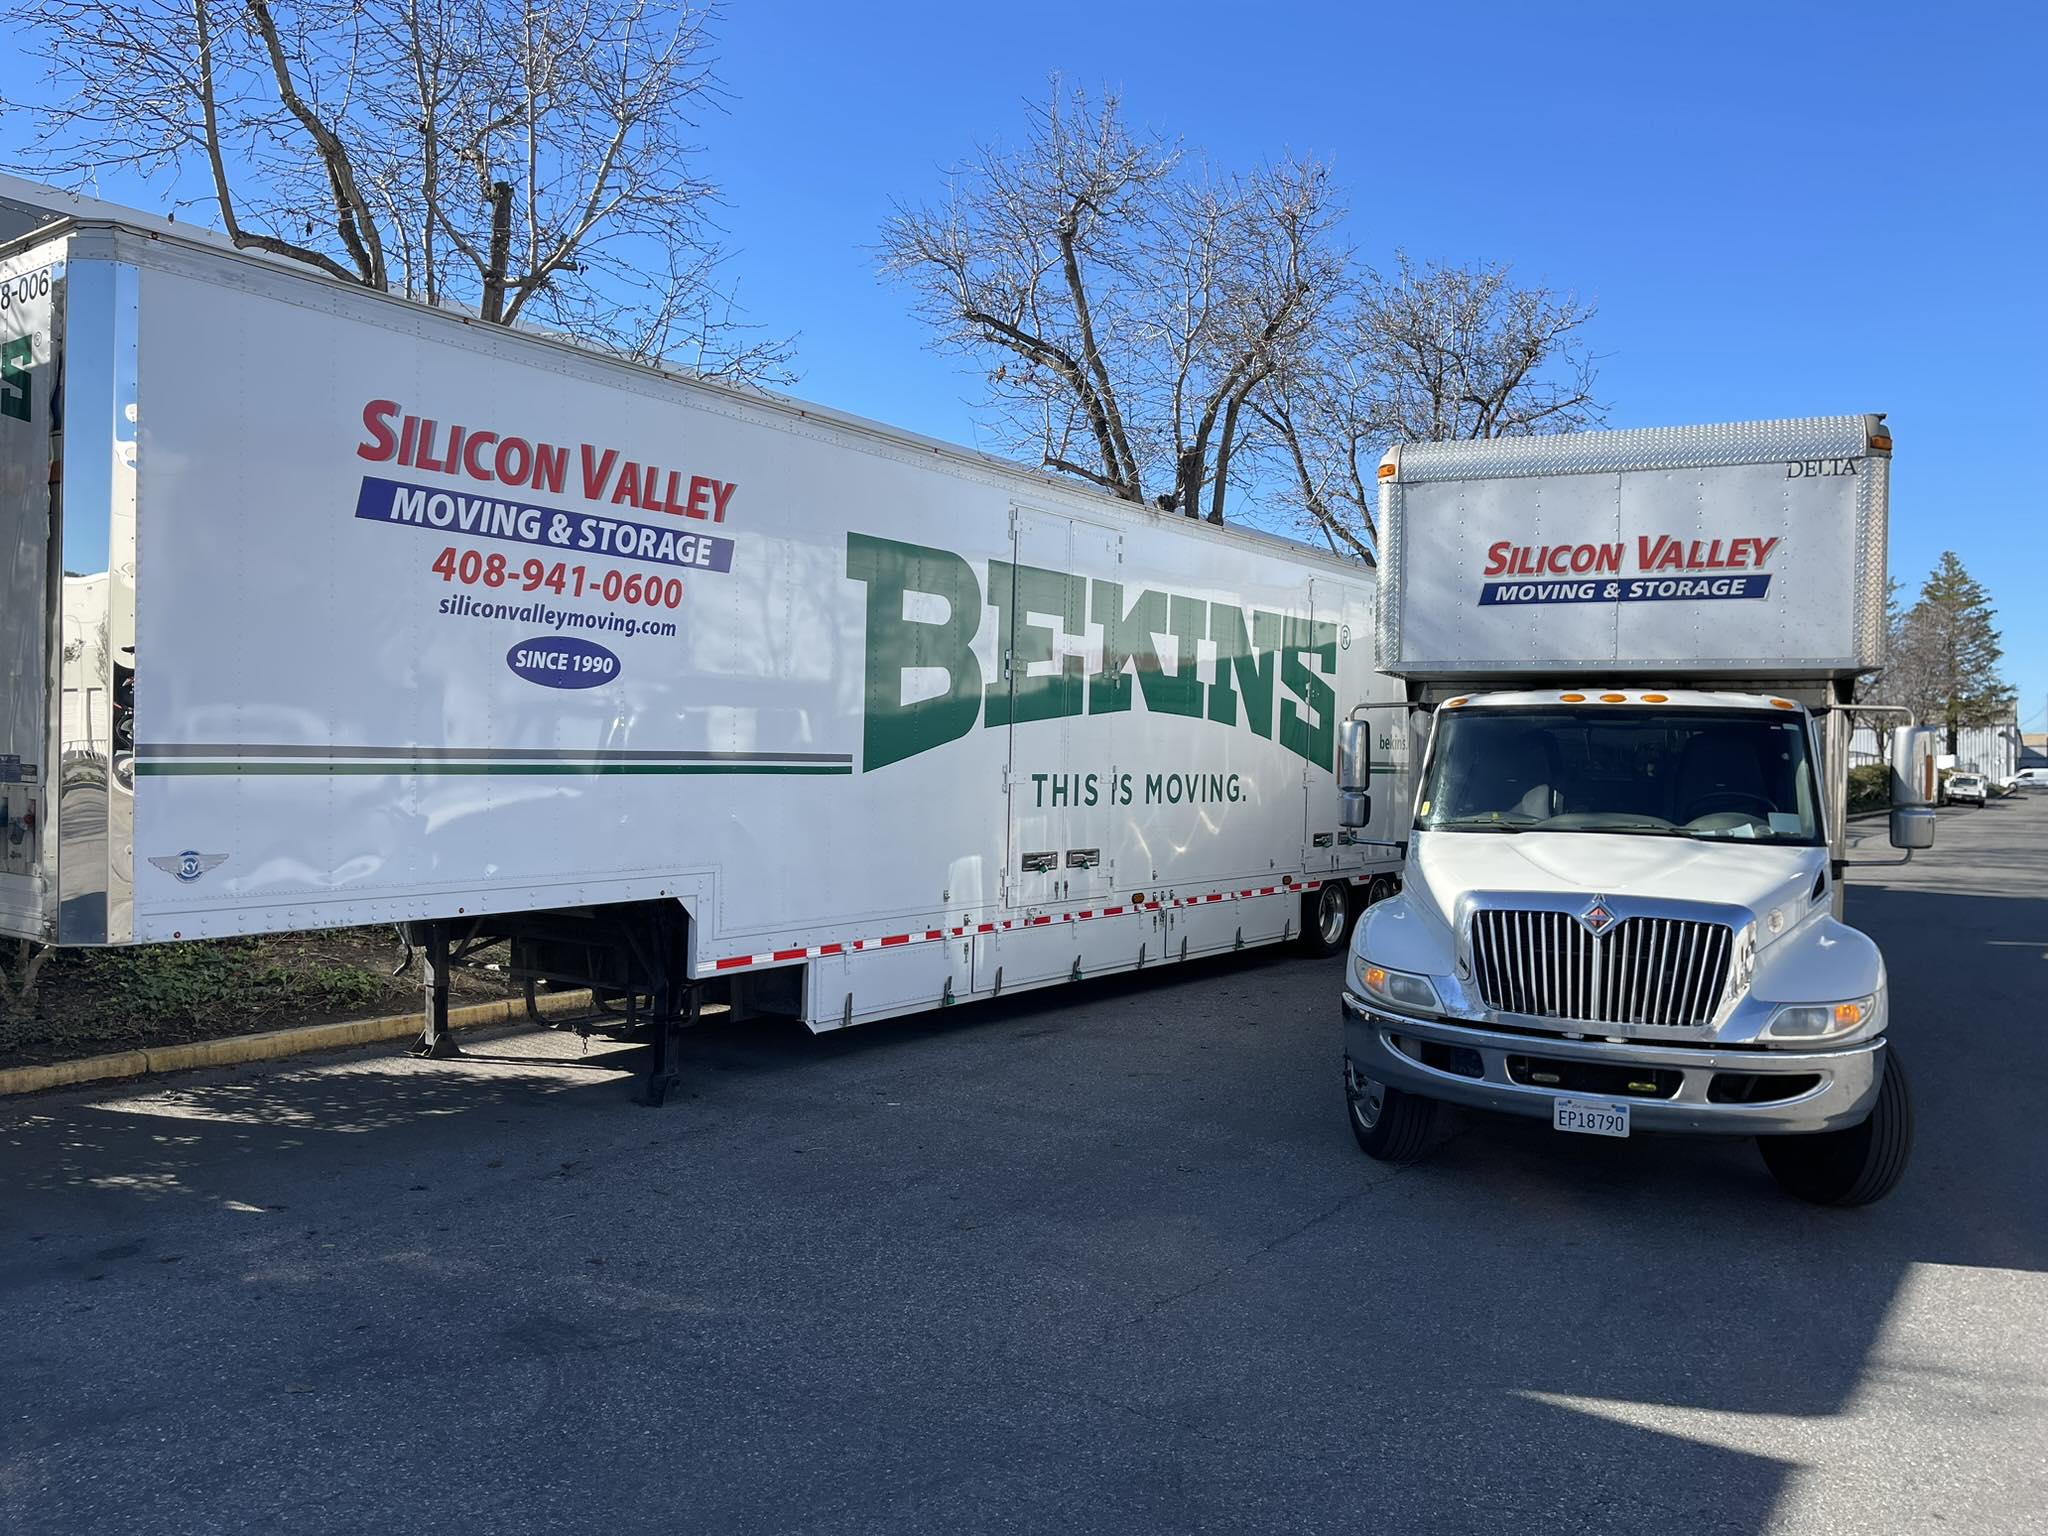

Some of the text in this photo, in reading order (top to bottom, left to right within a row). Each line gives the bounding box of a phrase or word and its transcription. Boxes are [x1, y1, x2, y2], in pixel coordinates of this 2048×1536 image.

[356, 399, 738, 524] SILICON VALLEY
[1787, 458, 1858, 479] DELTA
[390, 486, 714, 567] MOVING & STORAGE
[1483, 534, 1780, 577] SILICON VALLEY
[431, 546, 683, 609] 408-941-0600
[1495, 578, 1747, 601] MOVING & STORAGE
[438, 594, 677, 638] siliconvalleymoving.com
[515, 649, 614, 674] SINCE 1990
[846, 531, 1338, 774] BEKINS
[1031, 773, 1247, 808] THIS IS MOVING.
[1558, 1109, 1625, 1133] EP18790
